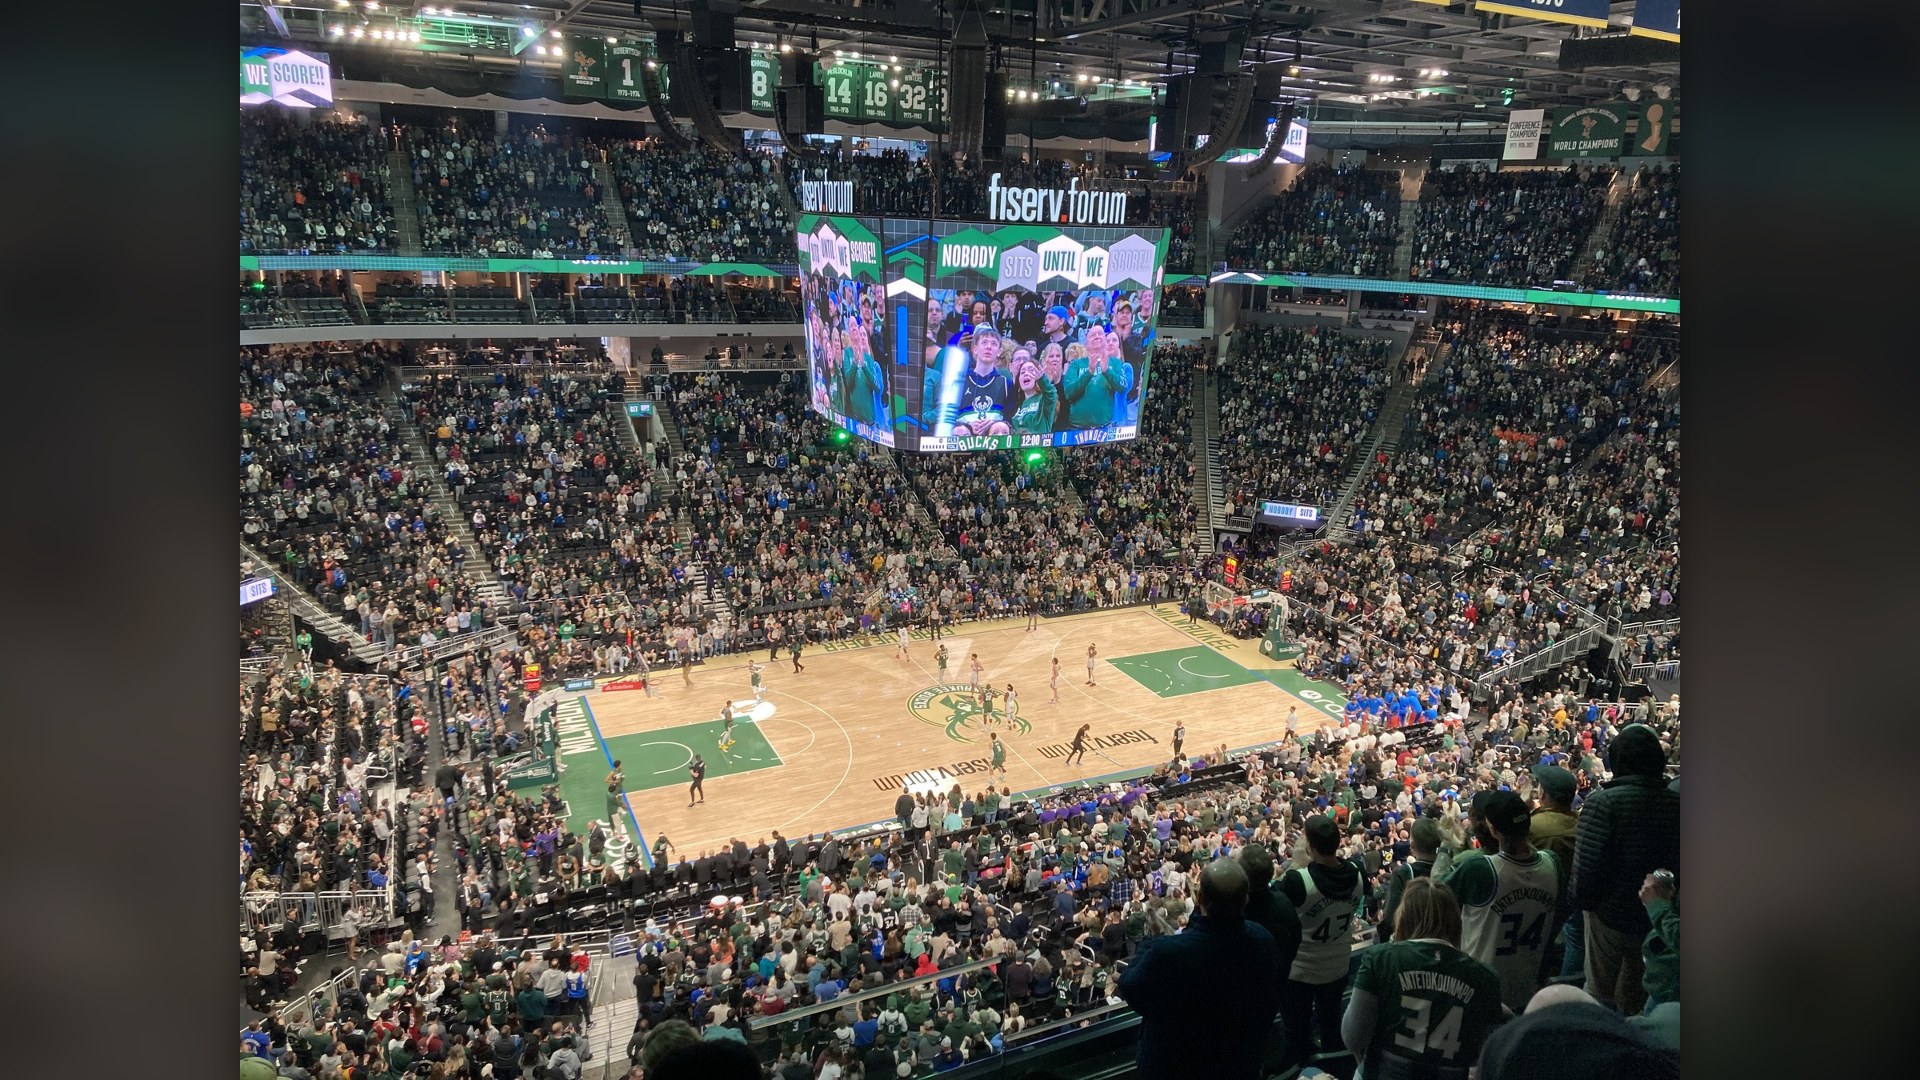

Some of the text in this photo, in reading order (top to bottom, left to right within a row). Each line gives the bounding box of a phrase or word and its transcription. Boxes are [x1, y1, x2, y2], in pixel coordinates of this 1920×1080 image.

[245, 62, 325, 86] WE SCORE!!
[622, 58, 634, 87] 1
[752, 70, 767, 97] 8
[827, 77, 852, 104] 14
[864, 80, 888, 107] 16
[900, 84, 926, 111] 32
[1510, 121, 1541, 130] CONFERENCE
[1510, 130, 1539, 138] CHAMPIONS
[1554, 138, 1619, 151] WORLD CHAMPIONS
[850, 240, 877, 264] SCORE!!
[942, 243, 1149, 279] NOBODY SITS UNTIL WE SCORE!!
[958, 435, 999, 451] BUCKS
[1006, 435, 1012, 448] 0
[1021, 434, 1040, 447] 12:00
[1061, 431, 1067, 444] 0
[1074, 429, 1108, 445] THUNDER
[1269, 505, 1314, 518] NOBODY SITS
[251, 582, 267, 597] SITS
[1495, 911, 1547, 958] 34
[1398, 970, 1476, 1005] ANTETOKOUNMPO
[1394, 995, 1464, 1060] 34
